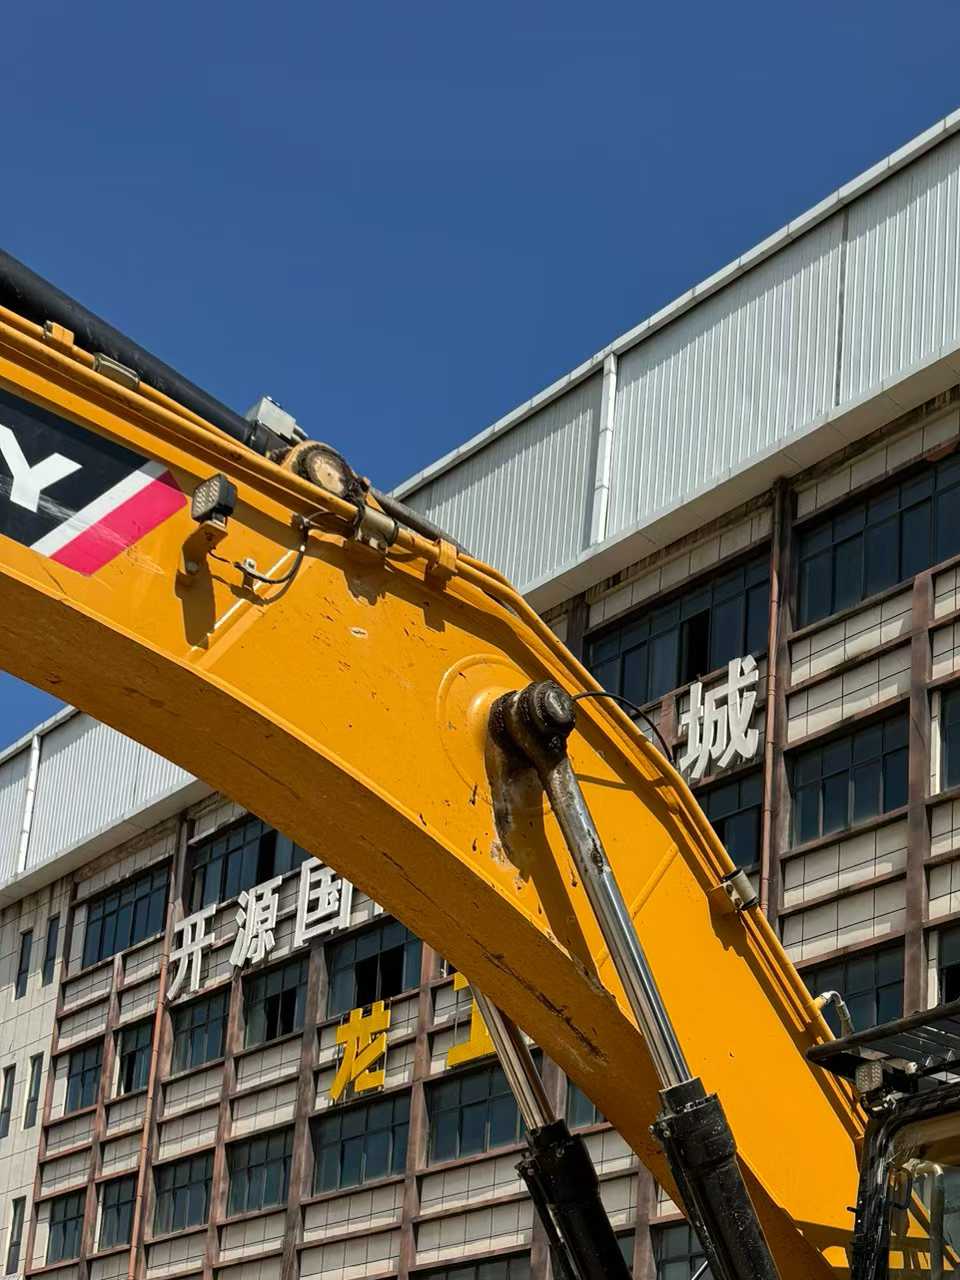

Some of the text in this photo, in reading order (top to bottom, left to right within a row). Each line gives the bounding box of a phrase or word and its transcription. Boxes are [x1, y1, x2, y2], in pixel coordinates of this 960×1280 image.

[678, 654, 759, 779] 城
[166, 856, 384, 1000] 开源国
